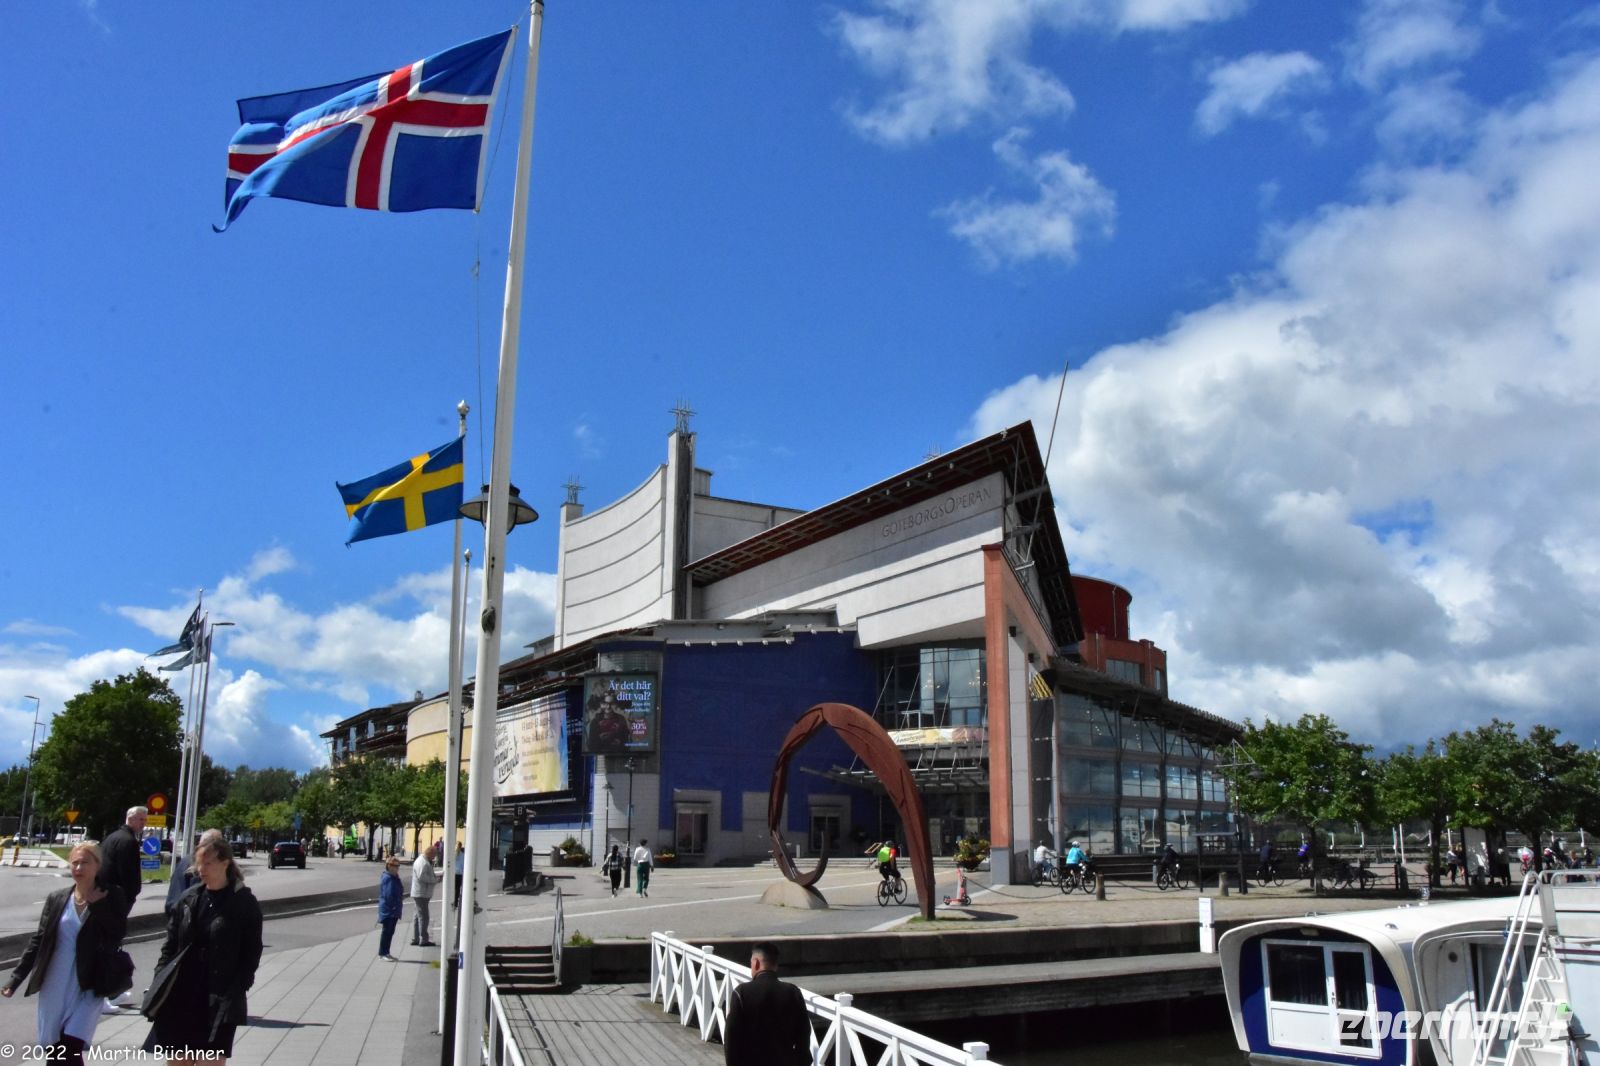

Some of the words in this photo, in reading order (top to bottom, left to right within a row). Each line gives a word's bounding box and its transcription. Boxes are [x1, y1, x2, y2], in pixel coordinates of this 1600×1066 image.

[608, 679, 620, 690] Är
[620, 680, 634, 690] det
[636, 680, 652, 690] här
[616, 691, 632, 701] ditt
[633, 691, 651, 701] val?
[631, 722, 647, 730] 30%
